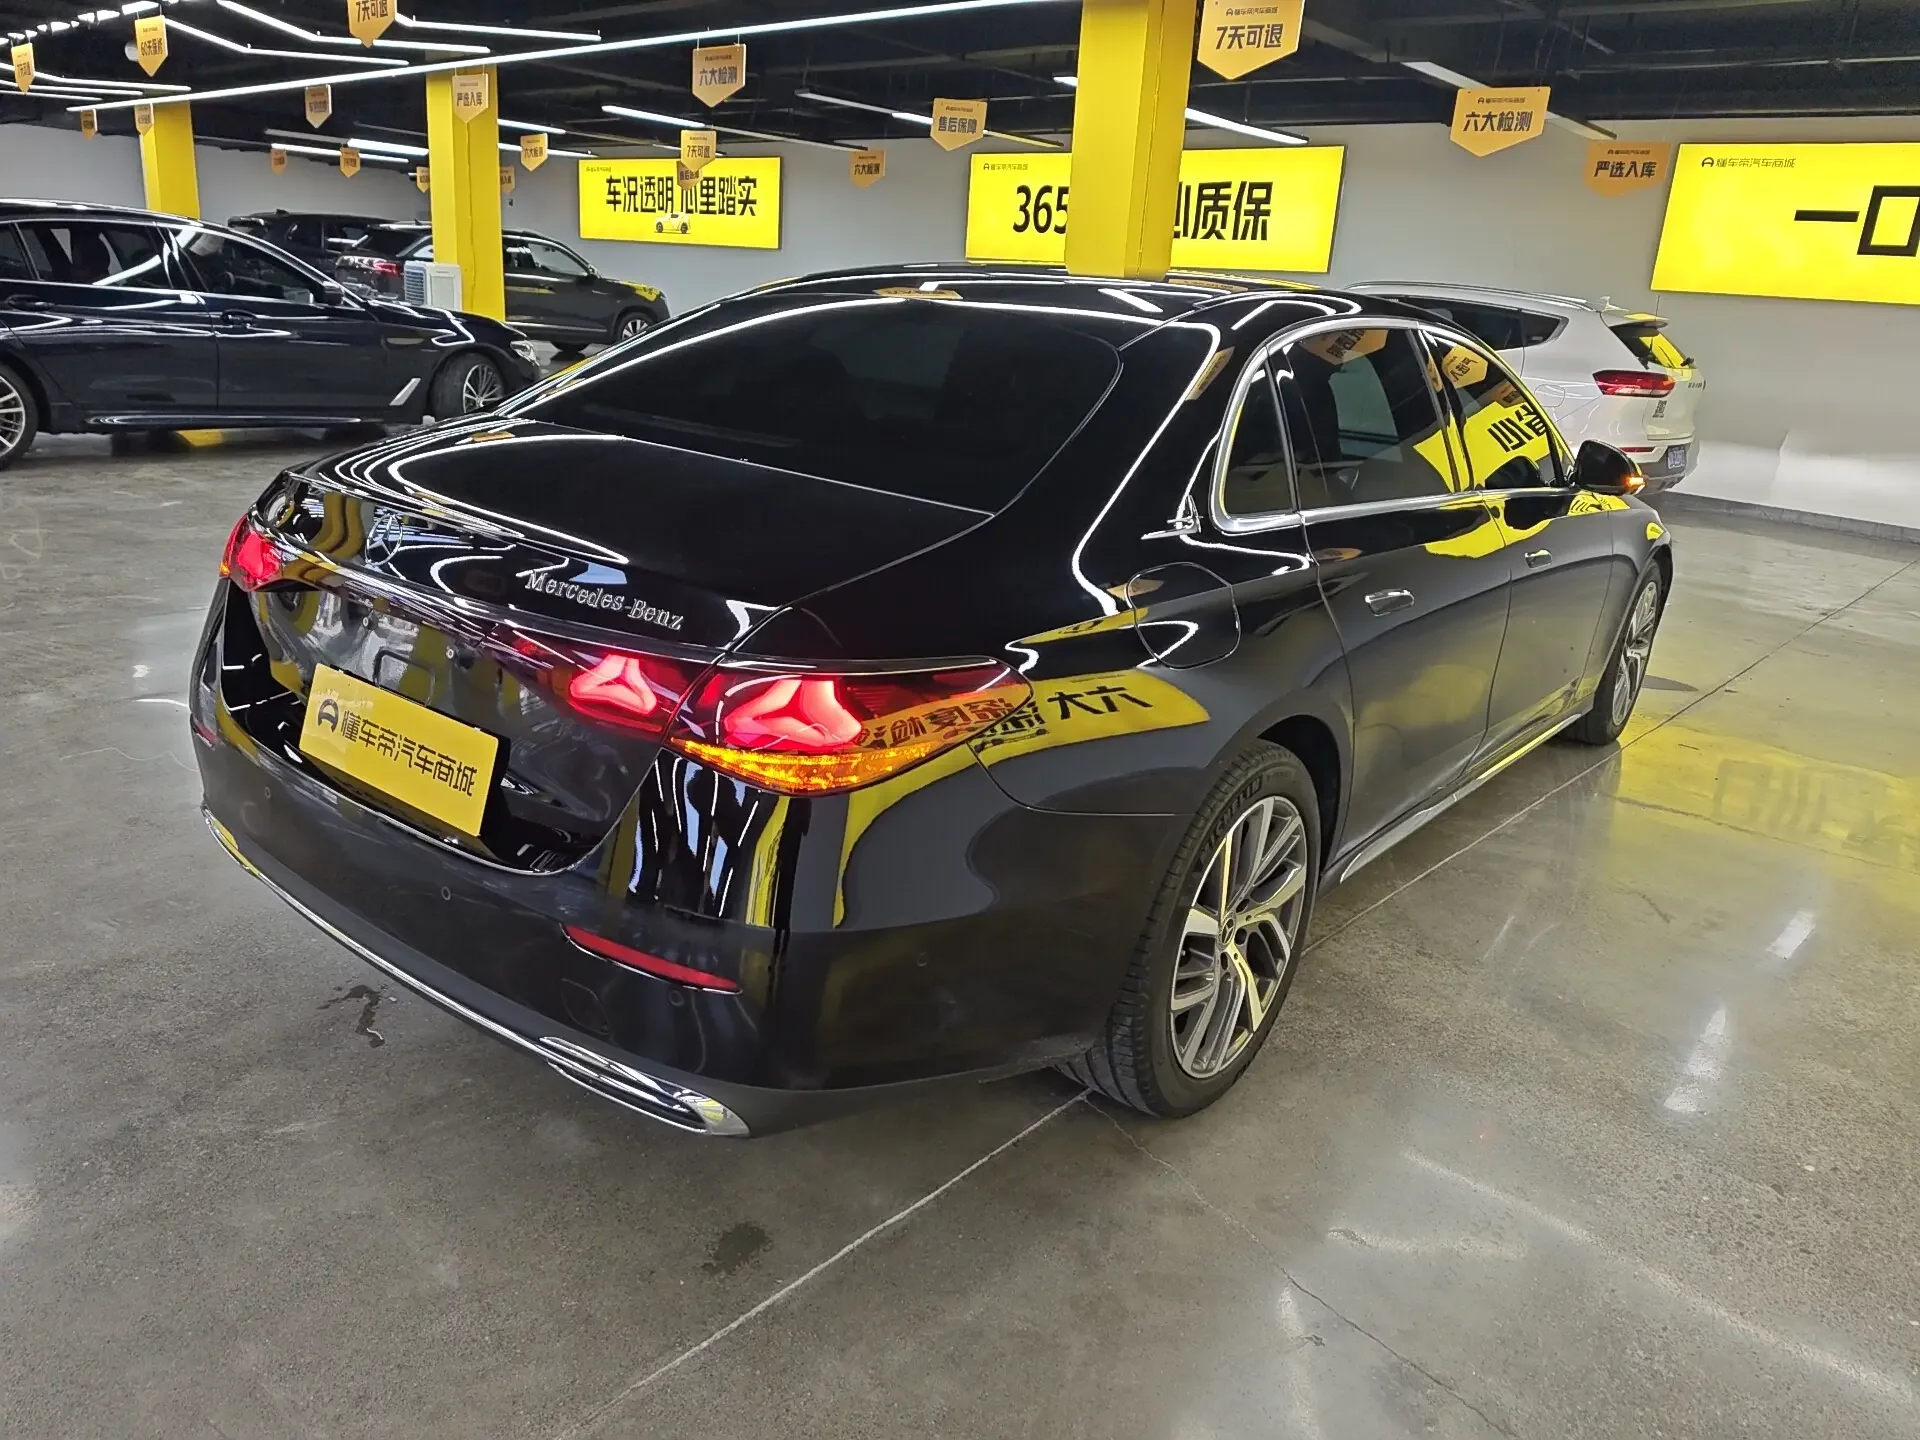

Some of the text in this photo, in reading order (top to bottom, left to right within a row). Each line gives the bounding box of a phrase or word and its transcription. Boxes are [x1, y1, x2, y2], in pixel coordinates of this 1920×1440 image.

[356, 0, 389, 22] 7天可退
[1216, 23, 1284, 49] 7天可退
[699, 66, 738, 86] 六大检测
[456, 91, 483, 107] 严选入库
[938, 116, 978, 135] 售后保障
[1462, 111, 1533, 132] 六大检测
[686, 144, 711, 159] 7天可退
[853, 163, 881, 175] 六大检测
[1594, 160, 1658, 178] 严选入库
[605, 175, 674, 213] 车况透明
[1012, 184, 1070, 235] 365
[1793, 185, 1920, 258] 一口
[524, 569, 685, 631] Mercedes-Benz
[340, 710, 479, 798] 懂车帝汽车商城
